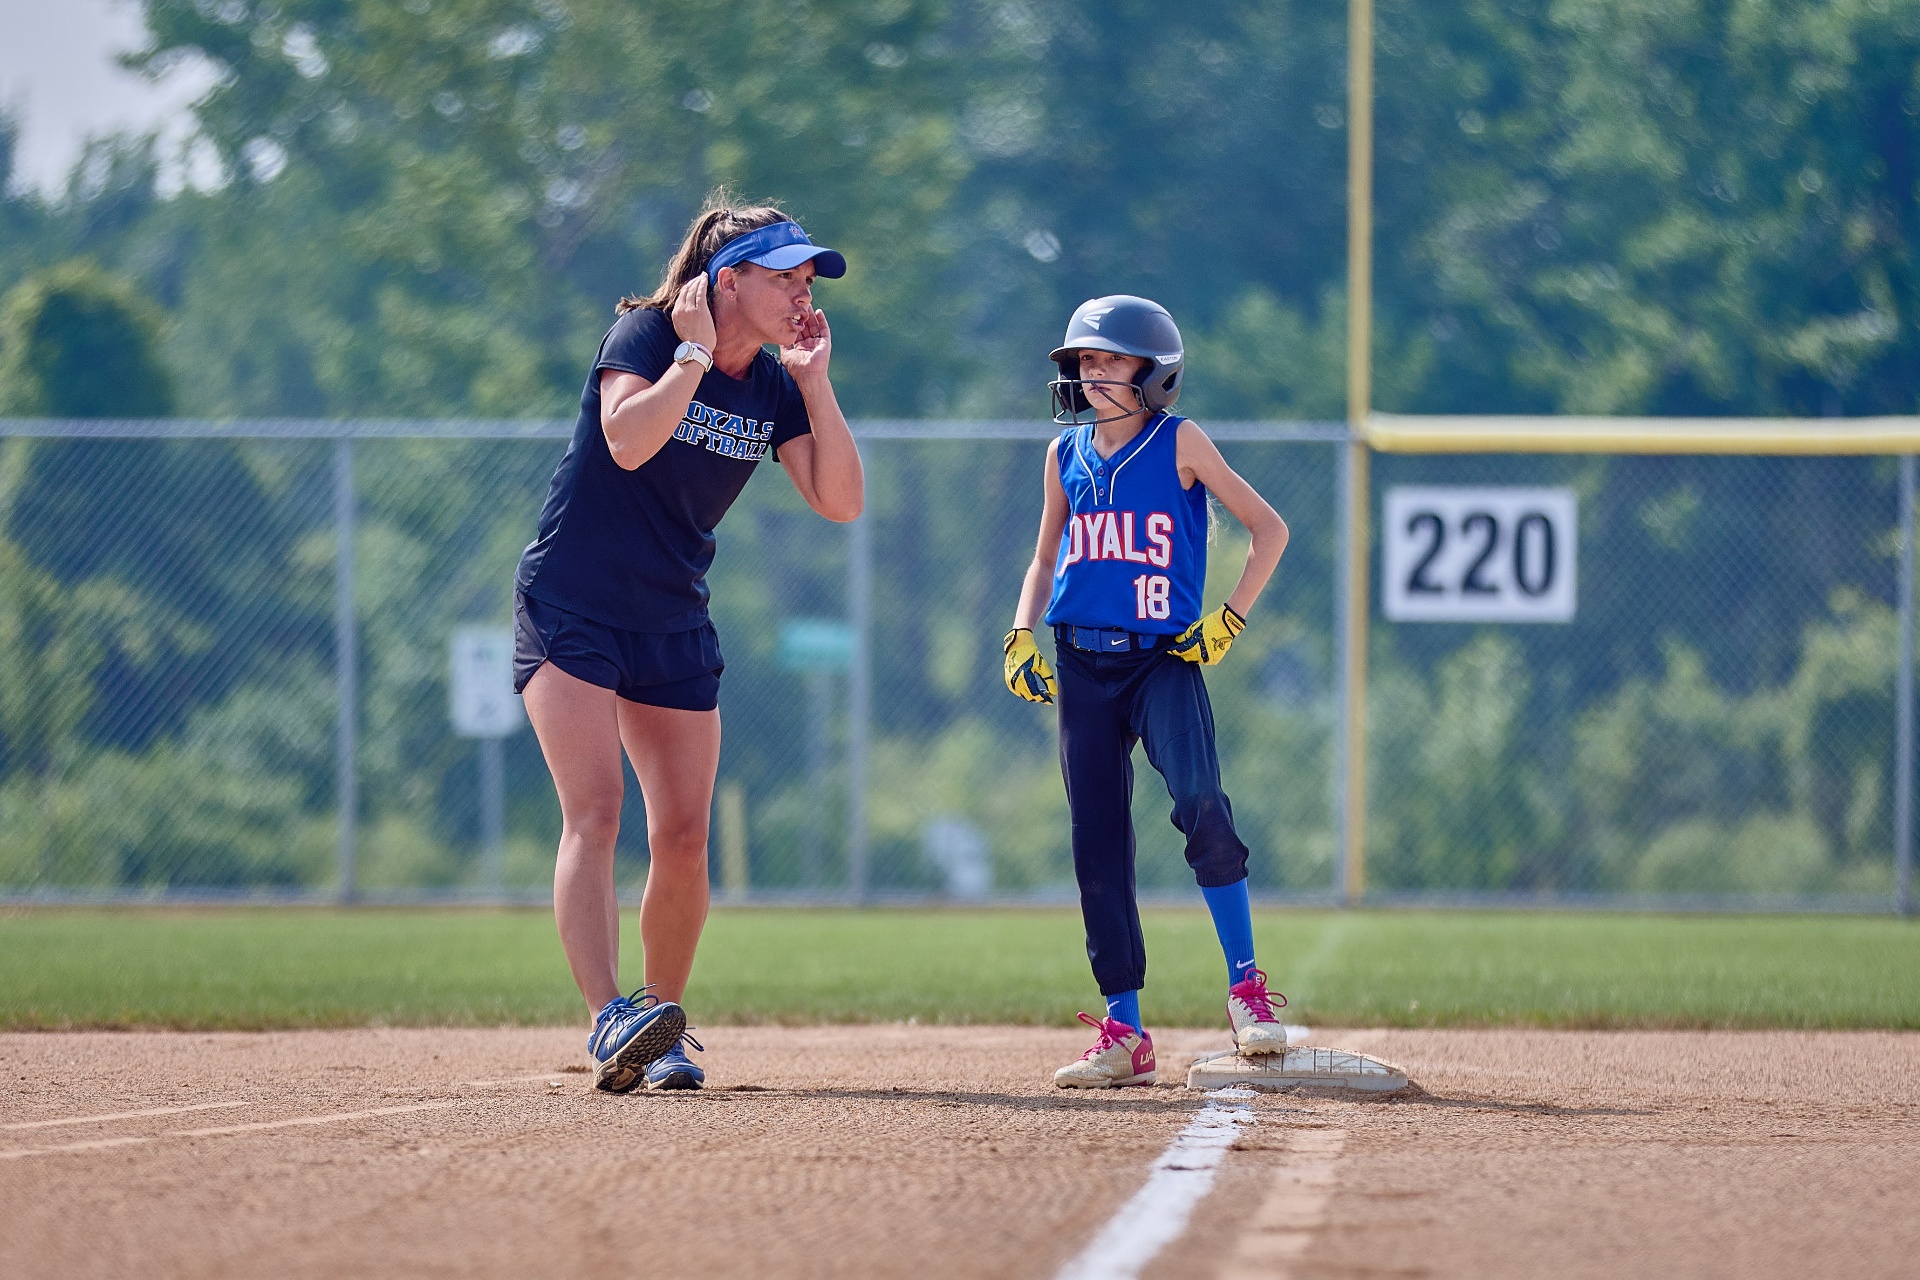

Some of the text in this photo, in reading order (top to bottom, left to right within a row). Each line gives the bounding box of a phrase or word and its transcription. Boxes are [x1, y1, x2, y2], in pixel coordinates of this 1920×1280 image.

[673, 420, 766, 461] OFTBALL
[685, 400, 774, 441] OYALS
[1066, 511, 1174, 570] OYALS
[1406, 510, 1557, 597] 220
[1133, 574, 1171, 620] 18
